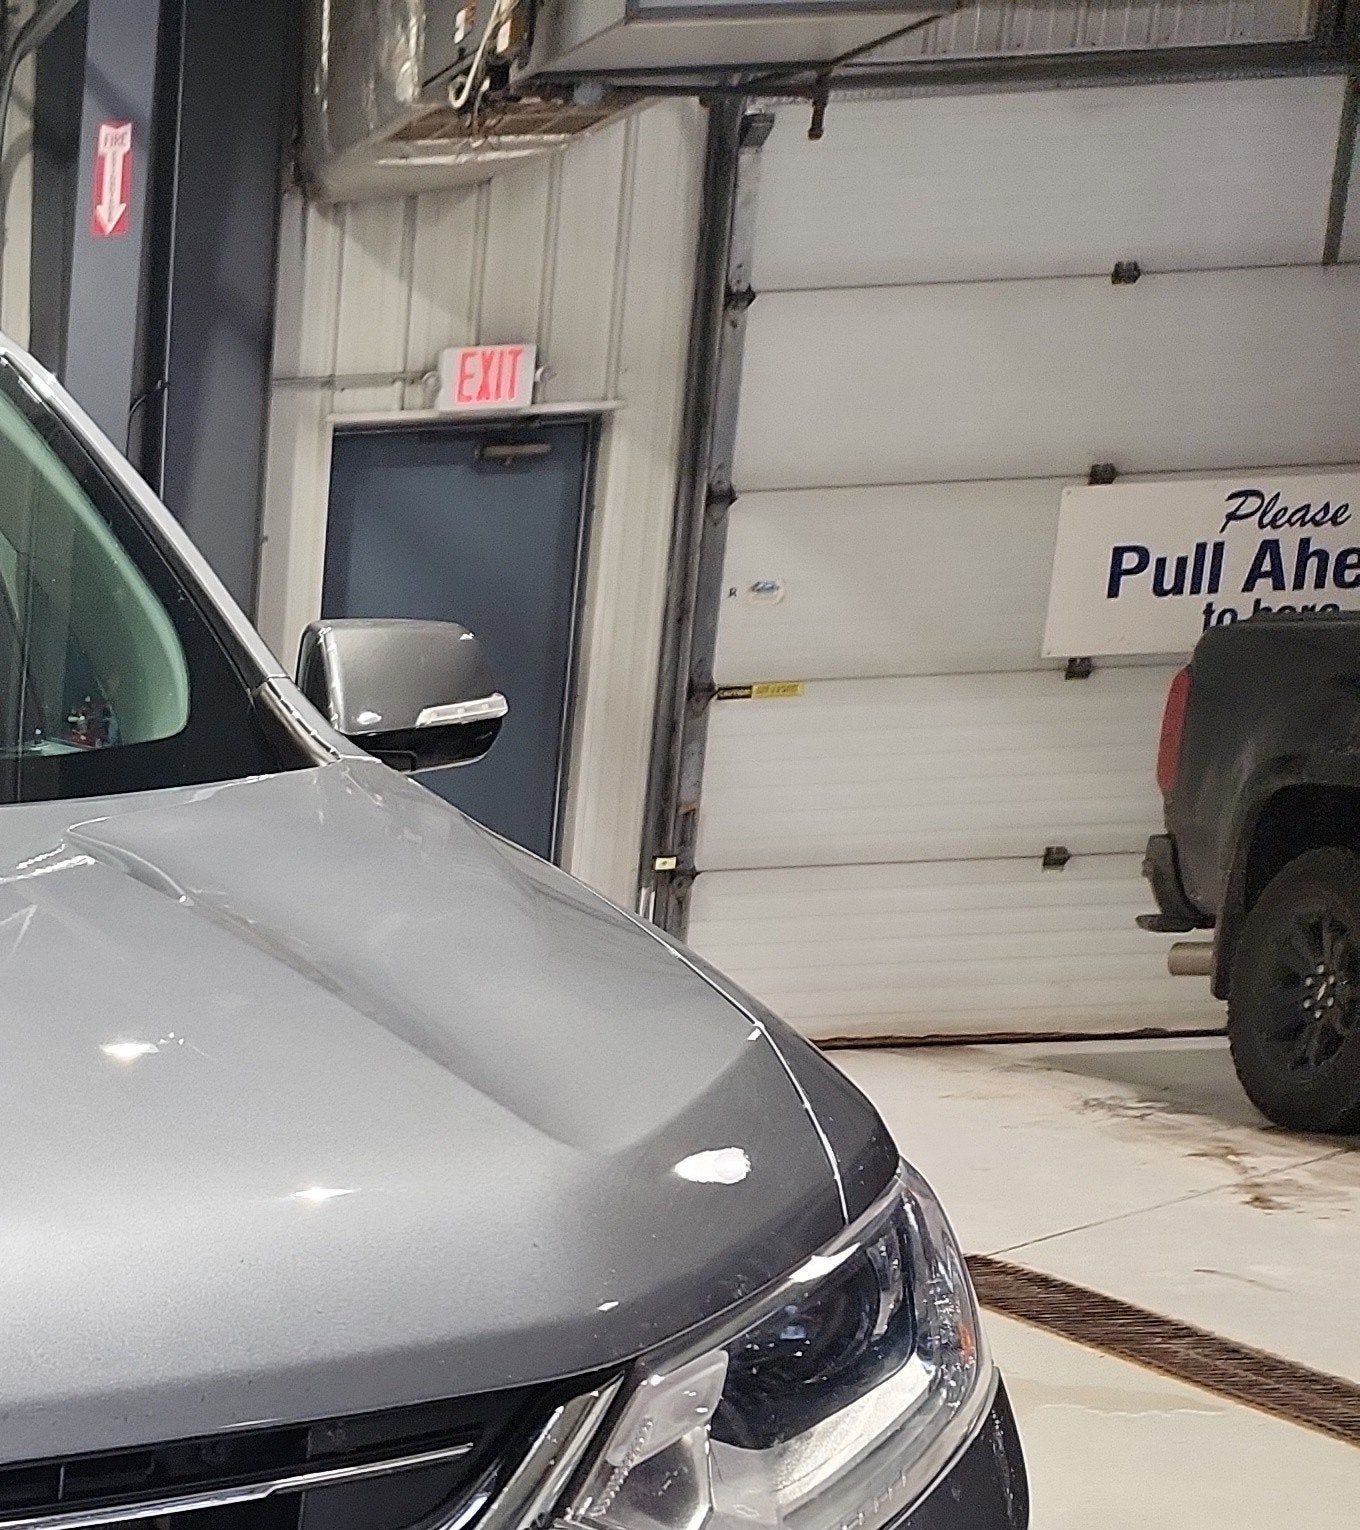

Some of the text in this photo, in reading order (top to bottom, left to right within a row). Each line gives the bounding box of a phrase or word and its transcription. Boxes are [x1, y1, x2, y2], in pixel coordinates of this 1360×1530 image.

[456, 347, 524, 403] EXIT
[1220, 489, 1352, 533] Please
[1106, 541, 1226, 599] Pull
